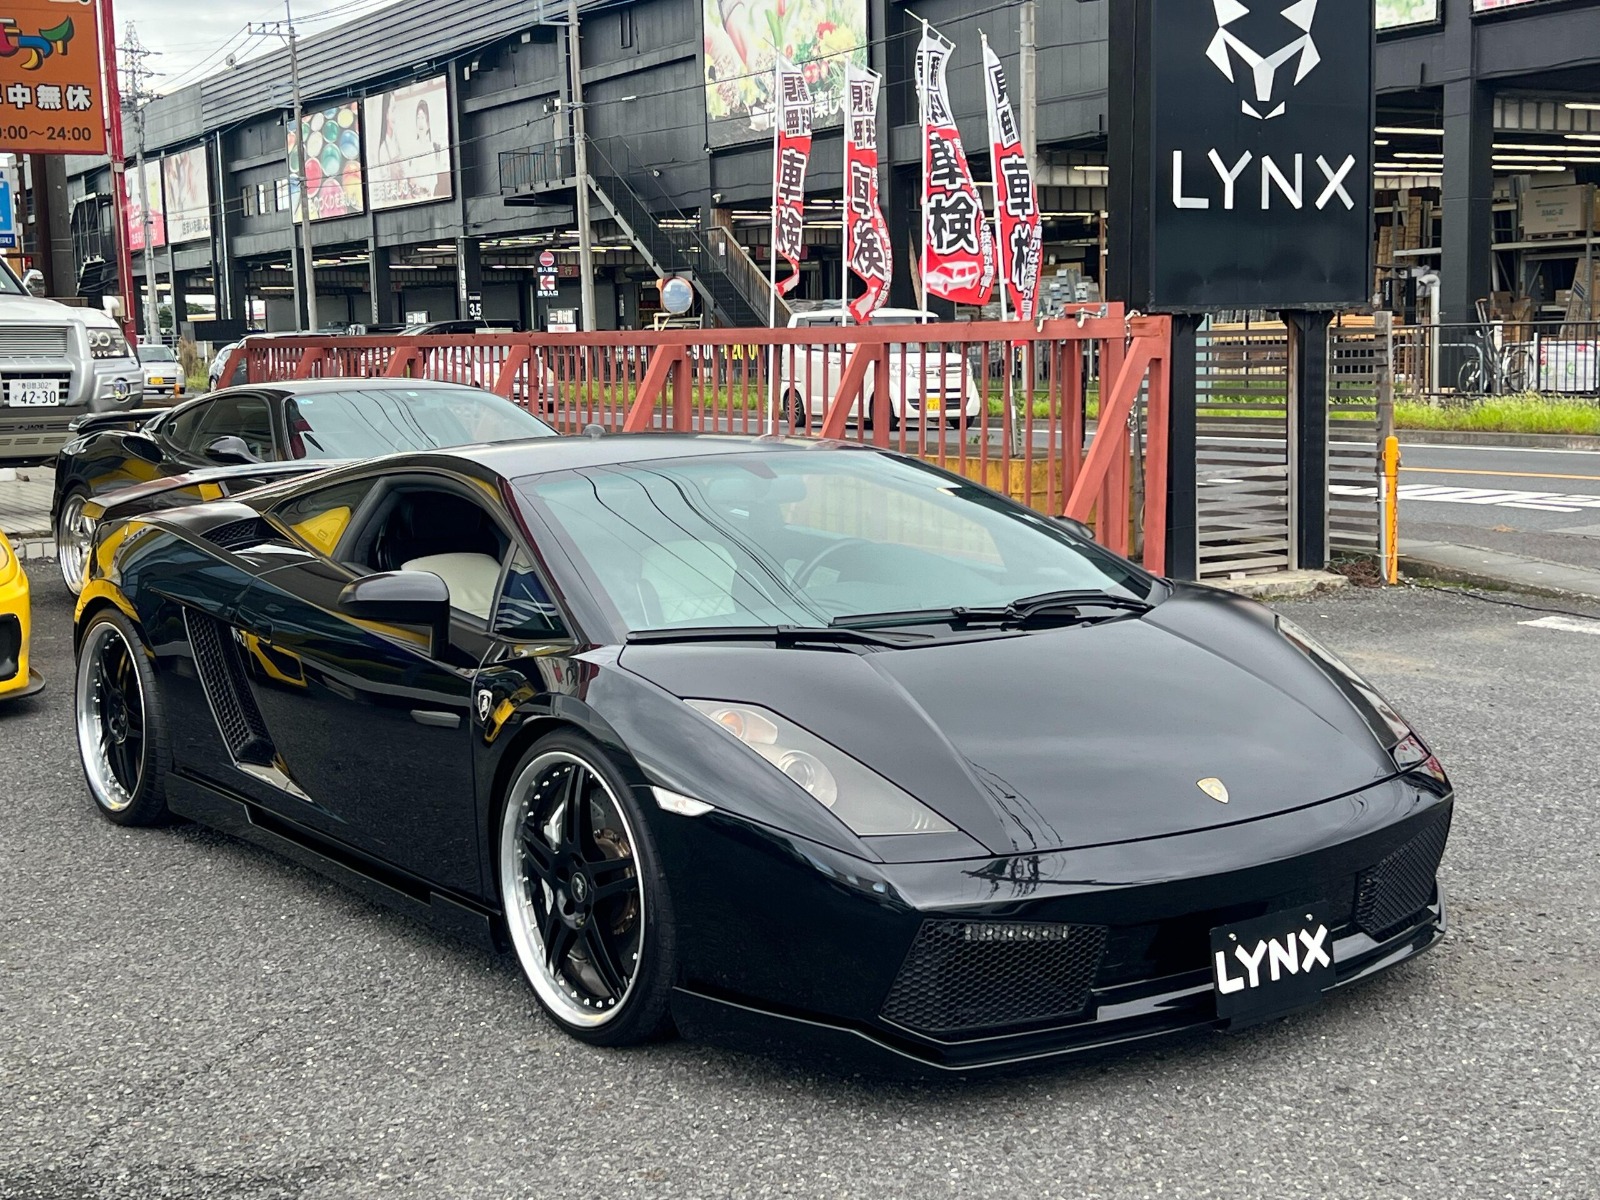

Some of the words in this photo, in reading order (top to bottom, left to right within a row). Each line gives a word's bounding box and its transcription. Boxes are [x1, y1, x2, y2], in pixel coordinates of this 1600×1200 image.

[0, 83, 92, 111] 中無休
[0, 125, 92, 141] :00～24:00
[1172, 148, 1356, 210] LYNX
[20, 390, 57, 404] 42-30
[1214, 923, 1332, 995] LYNX
